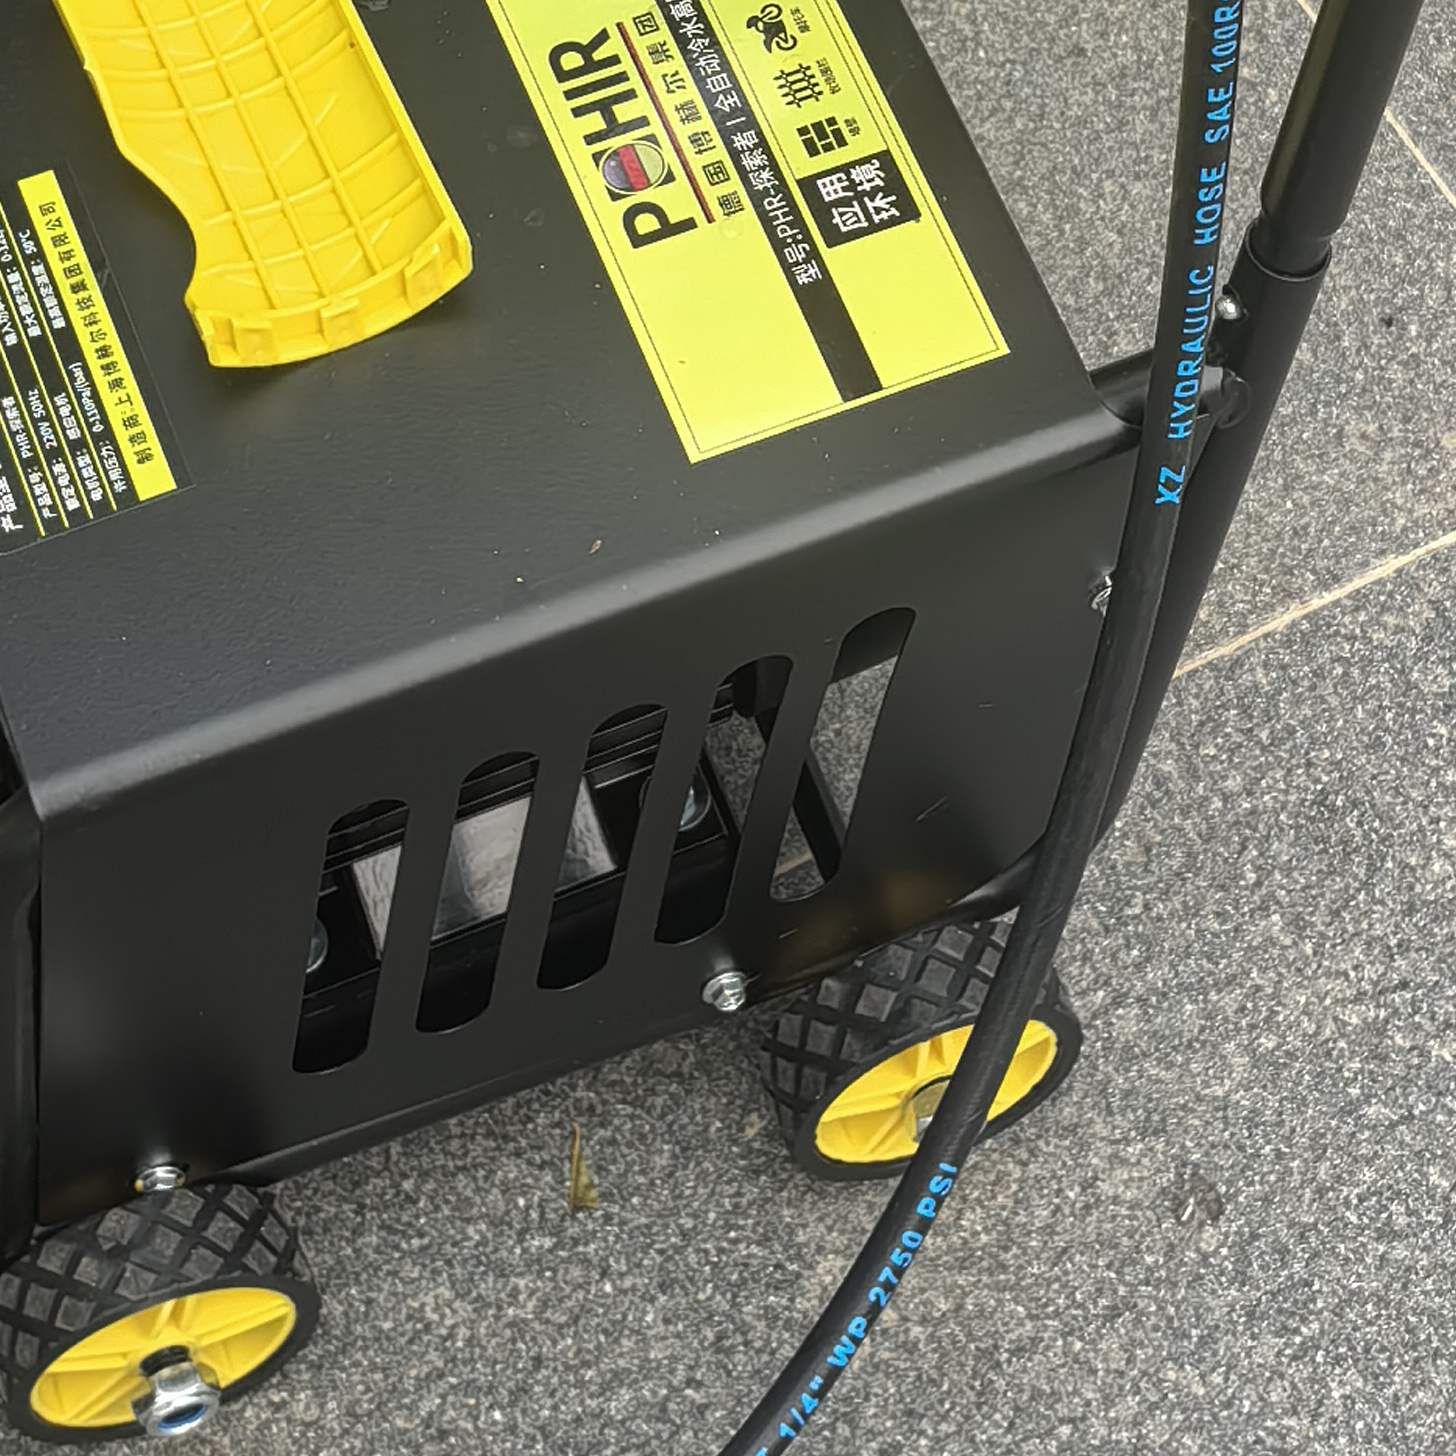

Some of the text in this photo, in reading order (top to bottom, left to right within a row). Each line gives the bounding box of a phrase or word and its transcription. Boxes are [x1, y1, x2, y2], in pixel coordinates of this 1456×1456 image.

[632, 12, 744, 217] 德国博赫尔集团
[1204, 81, 1234, 144] SAE
[817, 173, 868, 232] 应用
[850, 159, 900, 223] 环境
[1193, 160, 1227, 246] HOSE
[1167, 265, 1214, 439] HYDRAULIC
[38, 422, 57, 449] 220V
[1155, 465, 1186, 506] XZ
[826, 1316, 868, 1370] WP
[868, 1230, 924, 1308] 2750
[916, 1163, 957, 1221] PSI
